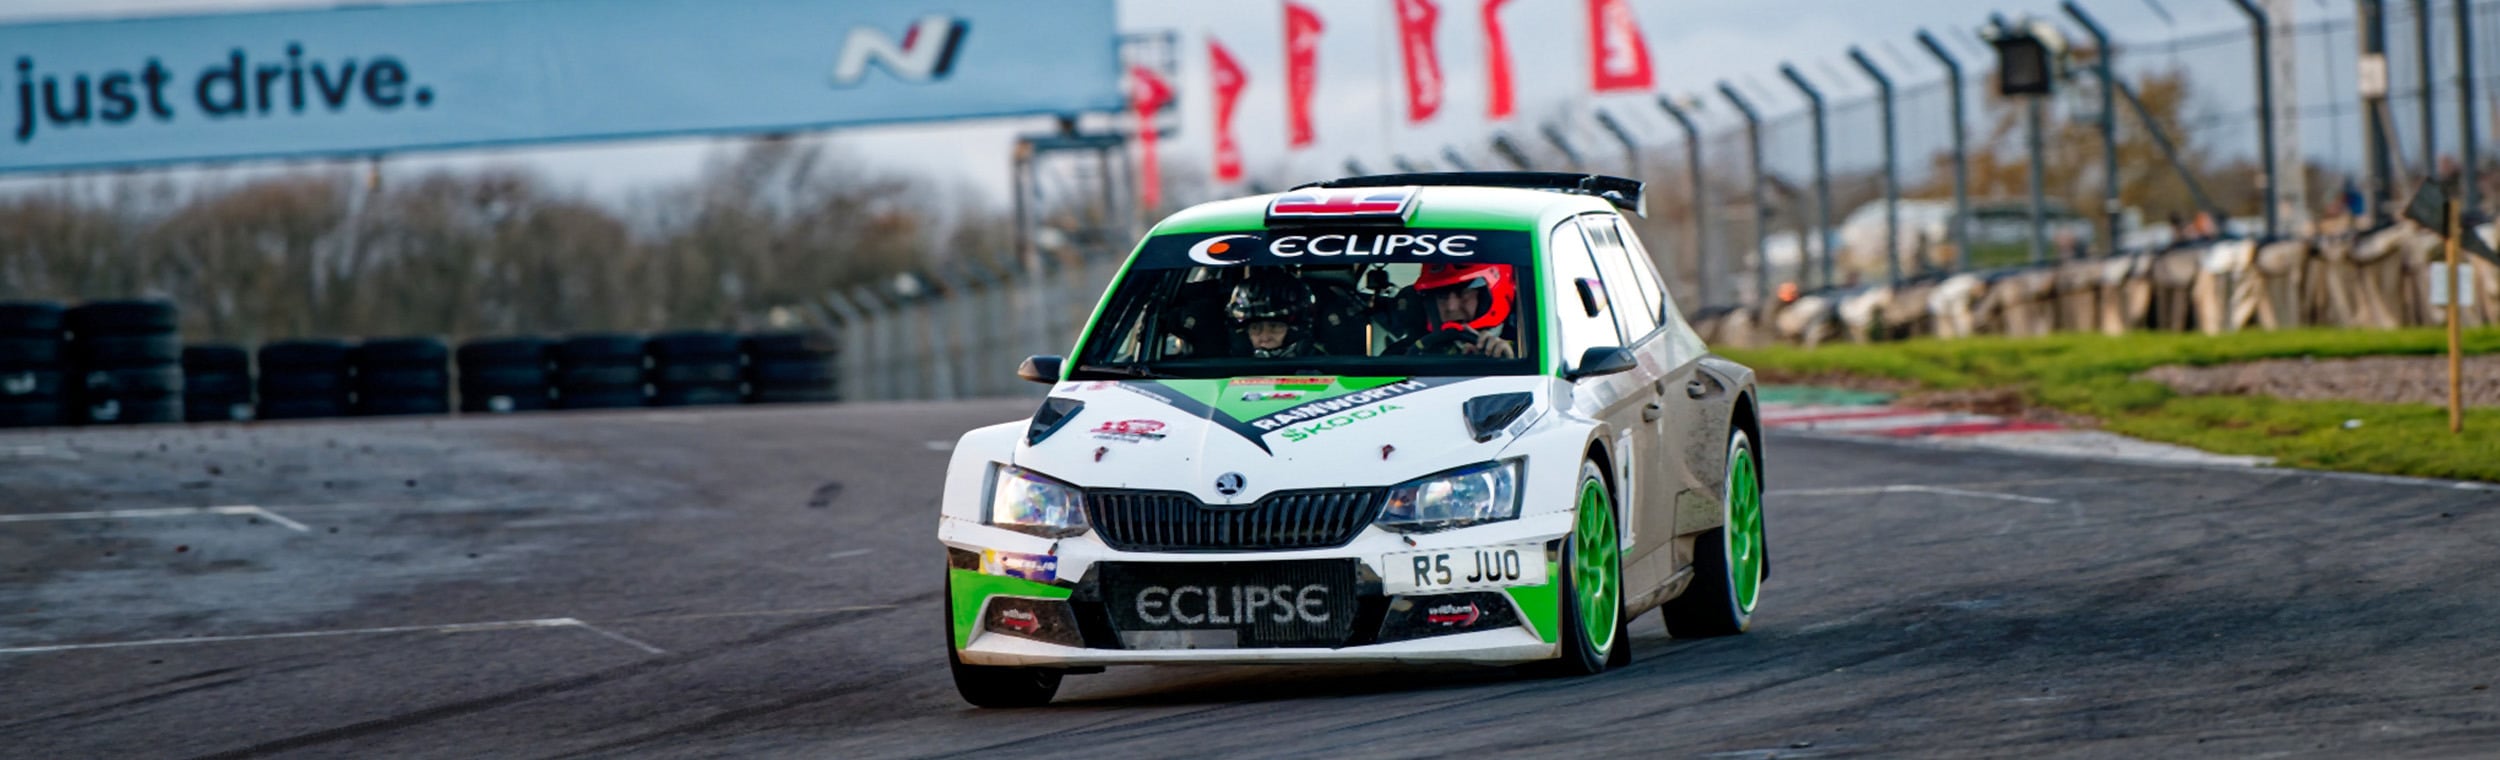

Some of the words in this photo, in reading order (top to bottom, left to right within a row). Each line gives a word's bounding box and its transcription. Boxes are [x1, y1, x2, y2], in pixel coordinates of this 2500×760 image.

[14, 55, 174, 142] just
[195, 42, 435, 117] drive.
[1269, 234, 1478, 257] ECLIPSE
[1252, 379, 1428, 430] RAINWORTH
[1413, 554, 1451, 587] R5
[1136, 584, 1330, 624] ECLIPSE
